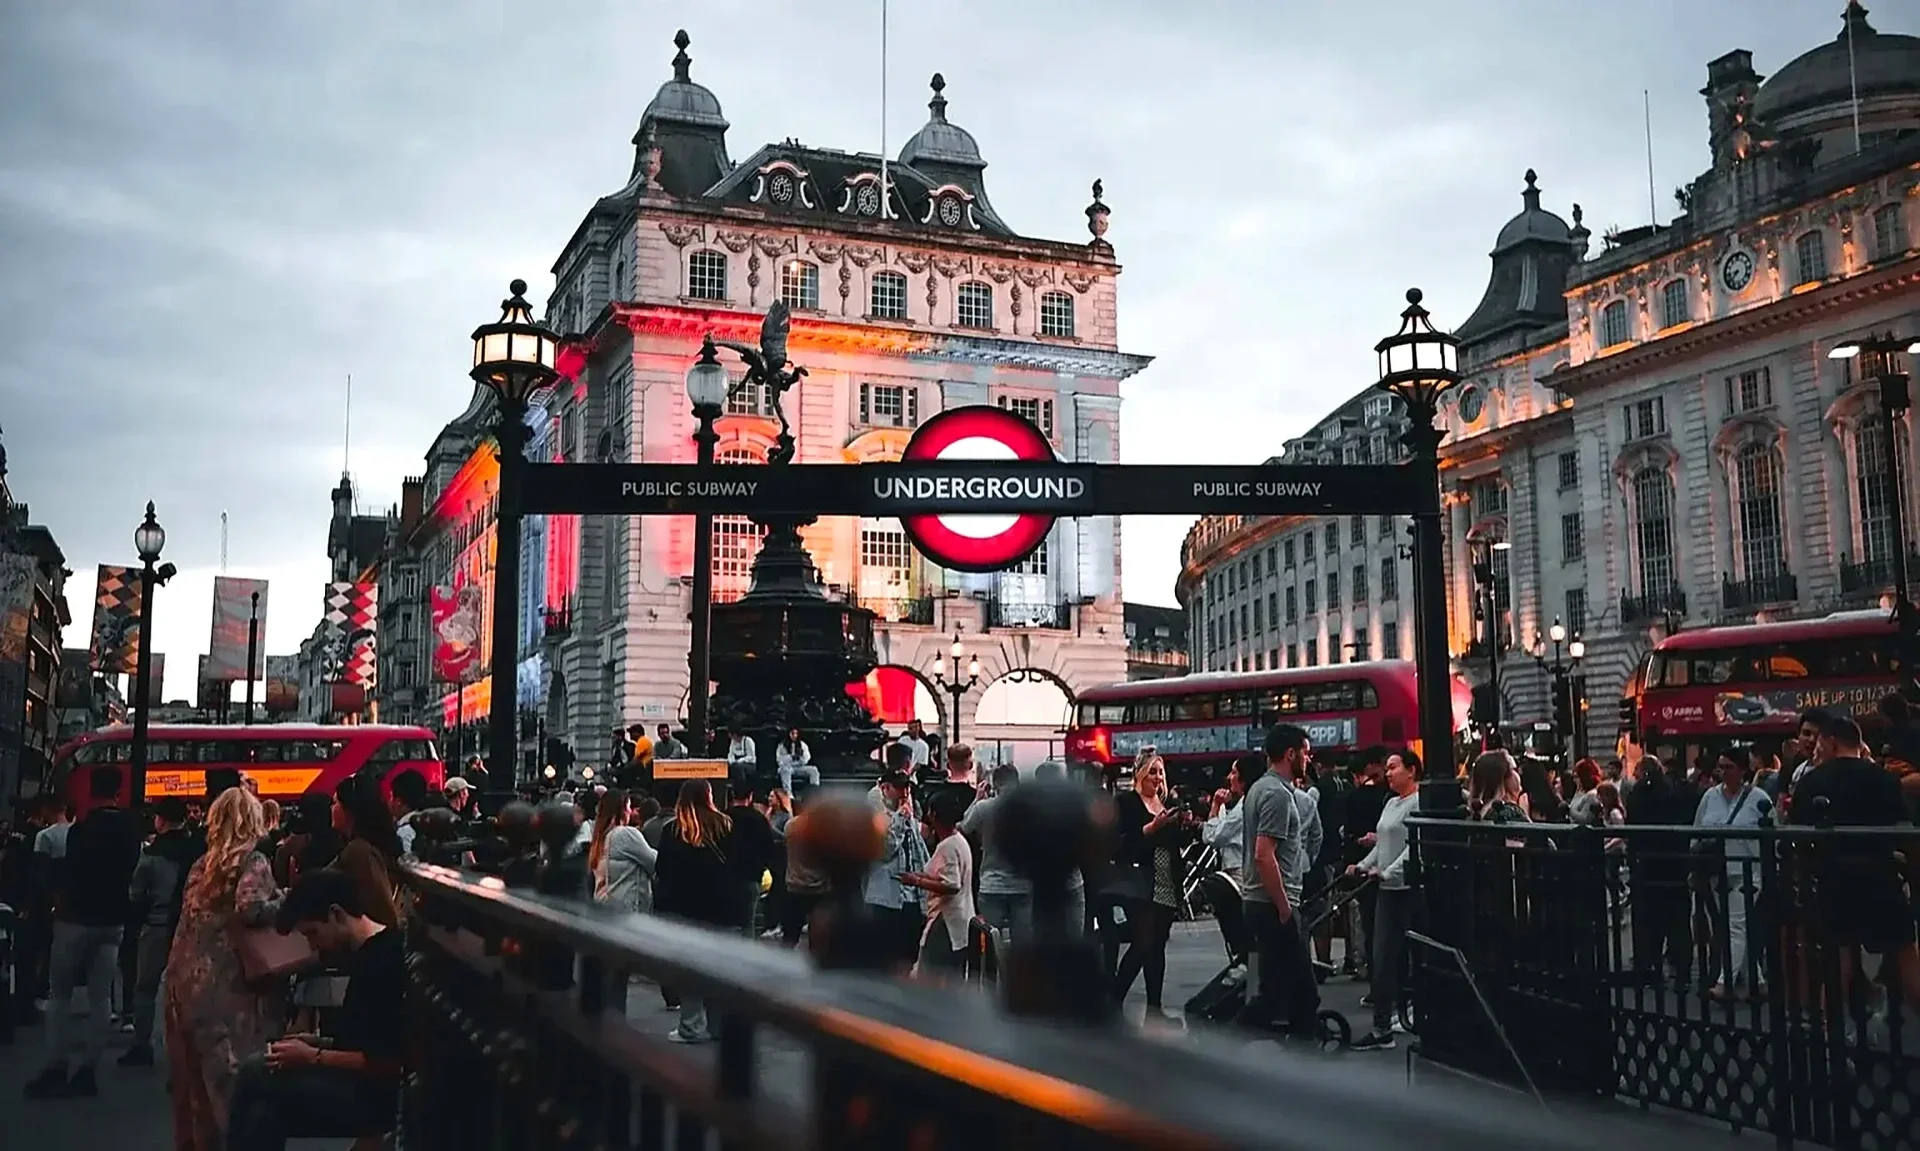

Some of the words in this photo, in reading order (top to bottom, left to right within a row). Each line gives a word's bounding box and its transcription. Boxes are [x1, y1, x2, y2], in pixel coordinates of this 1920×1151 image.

[622, 481, 682, 496] PUBLIC
[687, 481, 758, 496] SUBWAY
[873, 477, 1085, 499] UNDERGROUND
[1193, 482, 1250, 496] PUBLIC
[1255, 482, 1322, 496] SUBWAY
[1795, 690, 1829, 709] SAVE
[1831, 690, 1846, 704] UP
[1849, 689, 1863, 703] TO
[1850, 702, 1879, 716] YOUR
